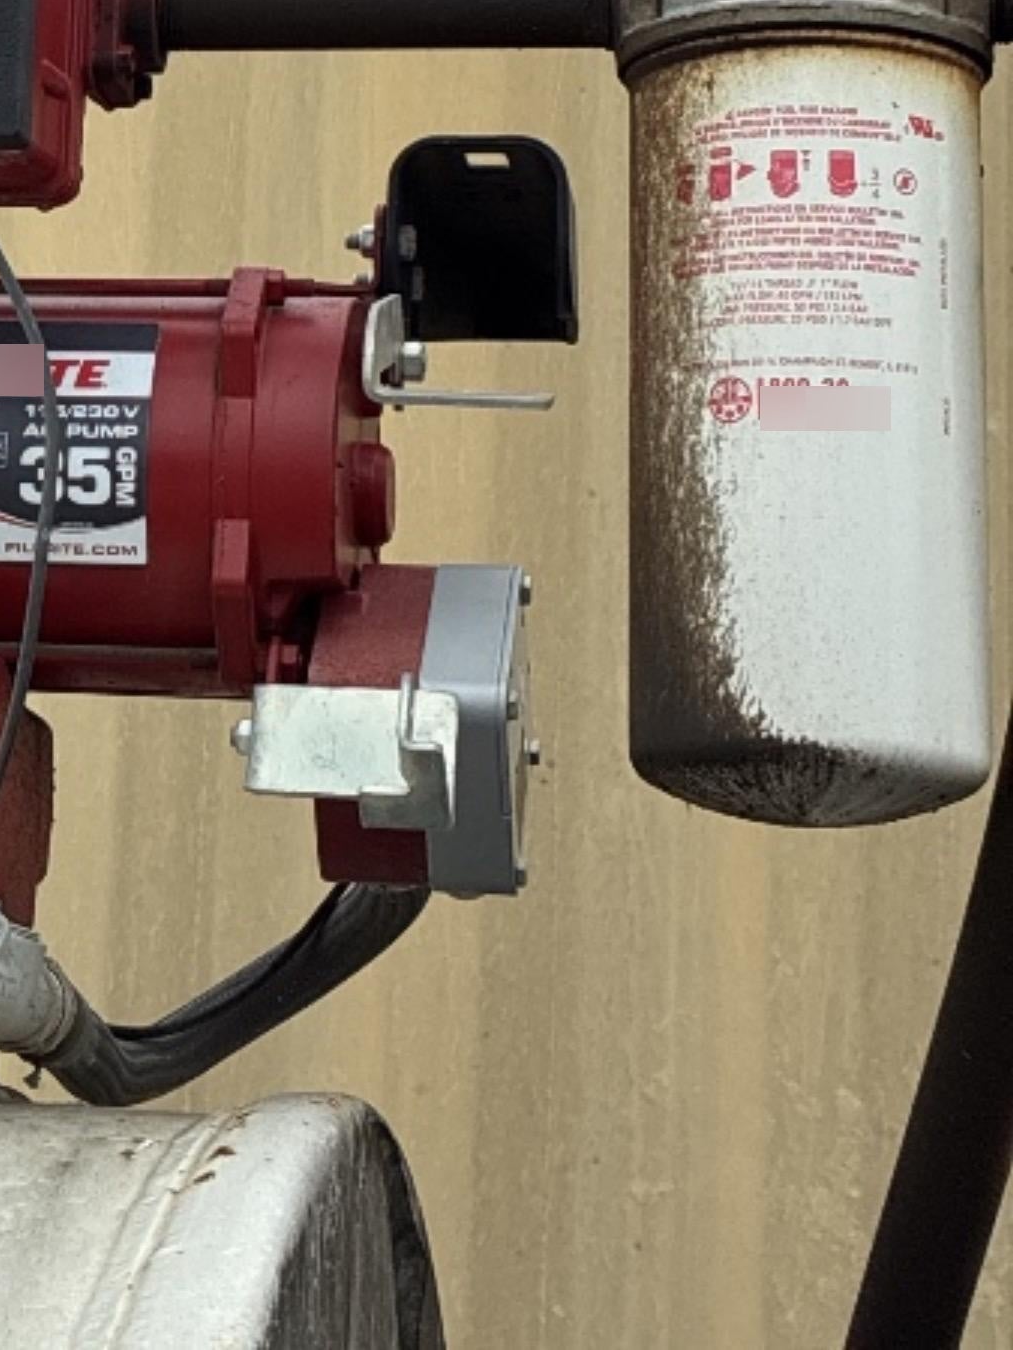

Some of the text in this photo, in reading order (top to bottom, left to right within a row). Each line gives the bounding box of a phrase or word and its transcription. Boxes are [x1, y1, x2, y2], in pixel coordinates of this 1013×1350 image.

[67, 422, 139, 439] PUMP
[122, 404, 140, 419] V
[19, 446, 112, 506] 35
[115, 446, 138, 507] GPM
